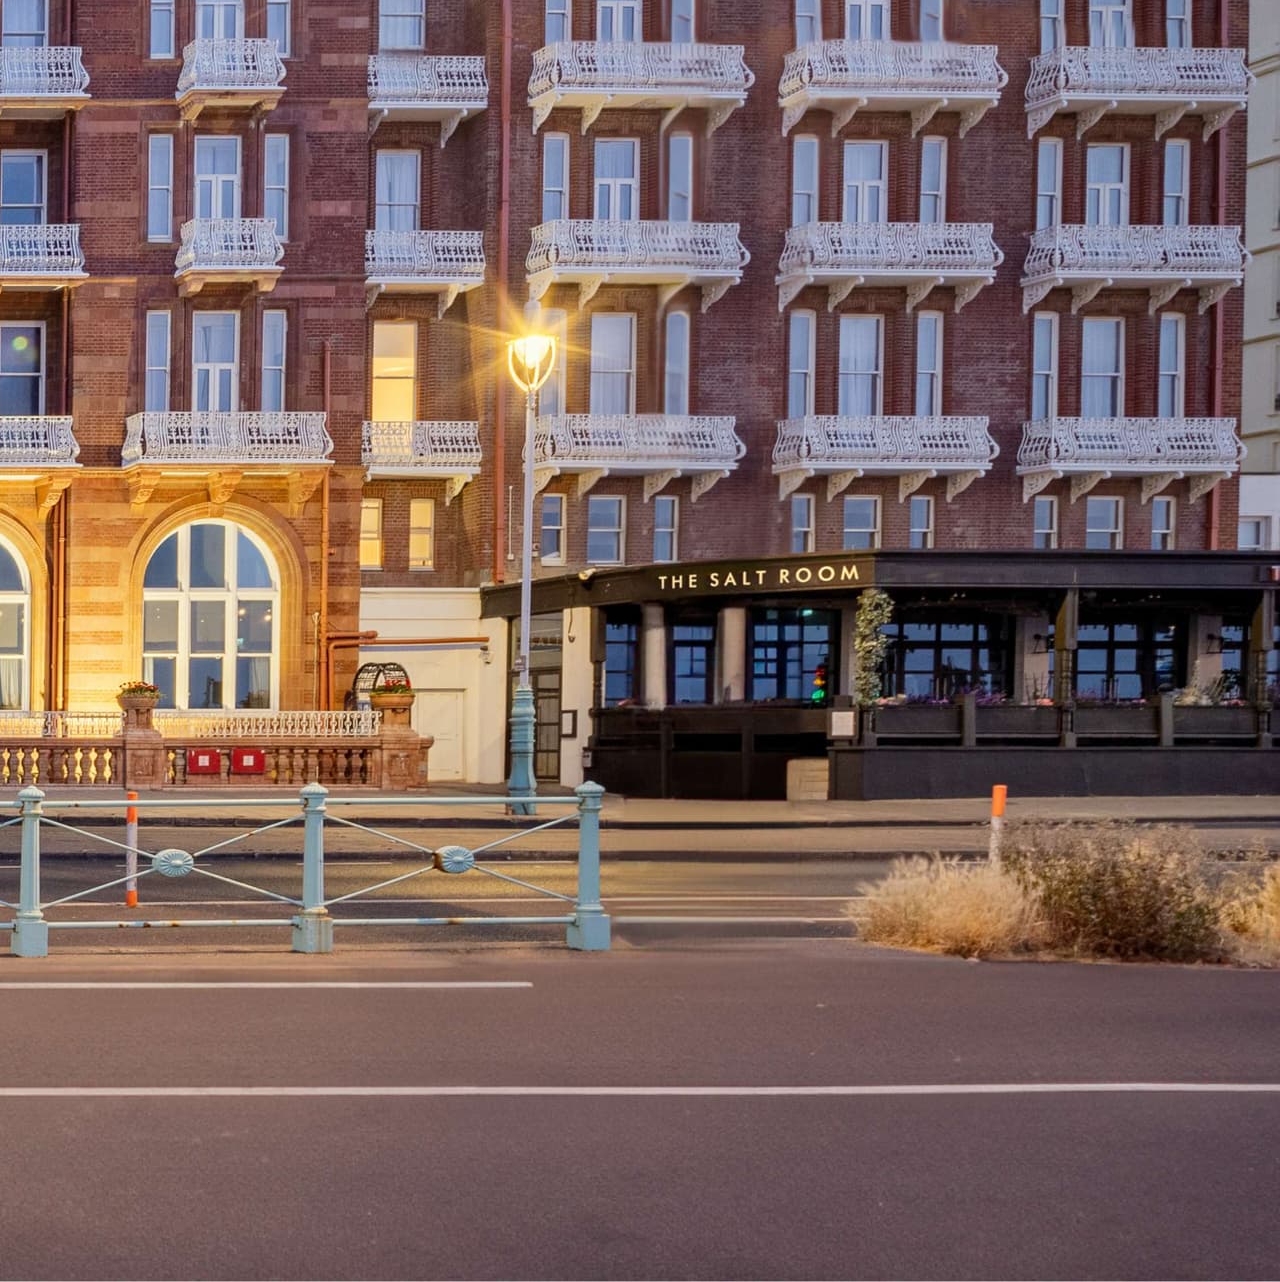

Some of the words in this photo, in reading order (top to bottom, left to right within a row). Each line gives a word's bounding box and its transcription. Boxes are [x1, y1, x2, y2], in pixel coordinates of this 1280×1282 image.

[658, 574, 698, 590] THE
[709, 570, 767, 587] SALT
[779, 565, 860, 584] ROOM
